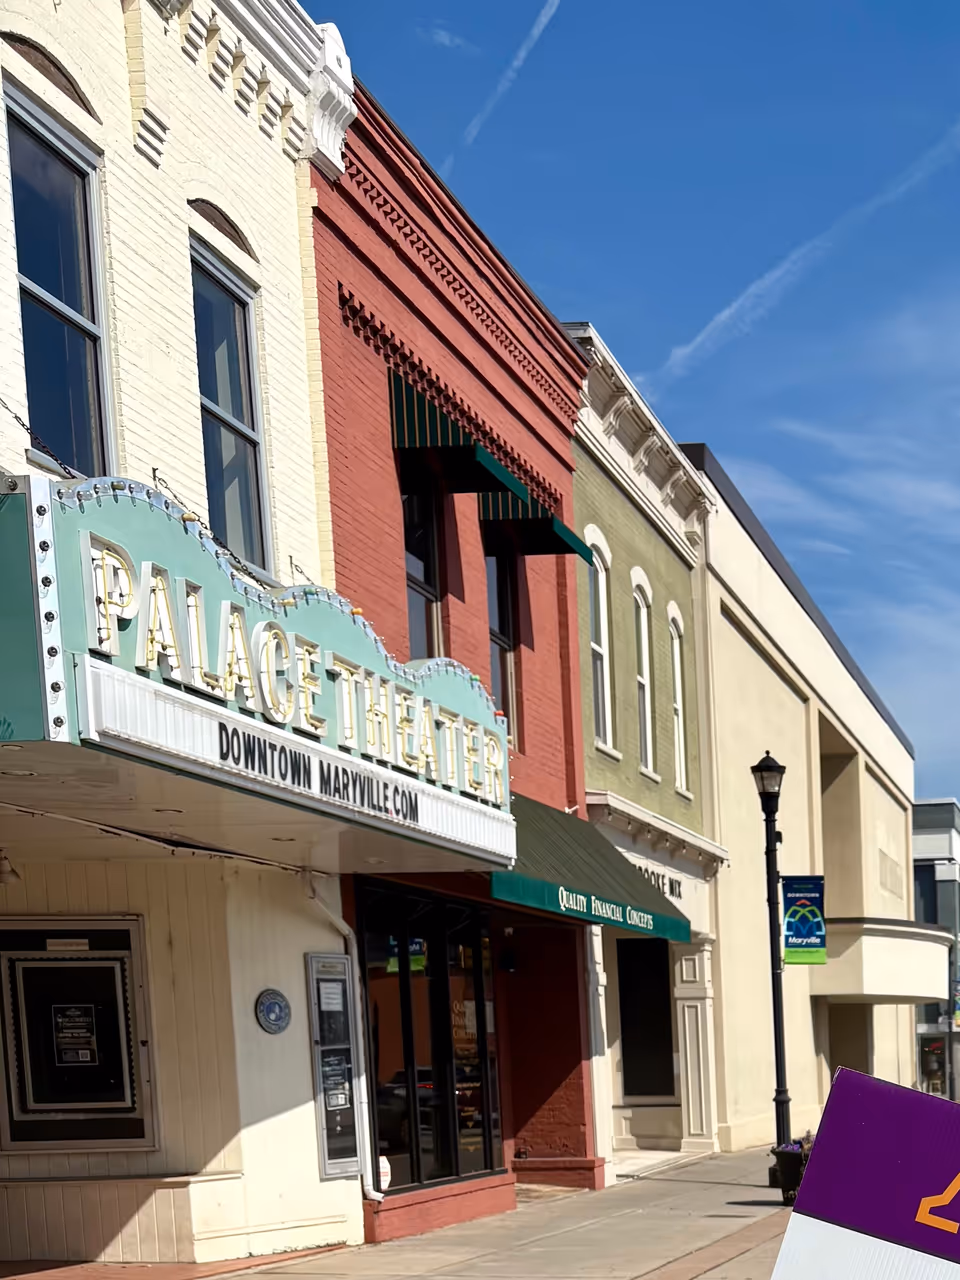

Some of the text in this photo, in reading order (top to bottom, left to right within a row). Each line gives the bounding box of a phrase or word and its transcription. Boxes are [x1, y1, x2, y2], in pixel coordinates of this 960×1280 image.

[79, 530, 508, 808] PALACE THEATER
[218, 722, 419, 823] DOWNTOWN MARYVILLE.COM
[558, 886, 653, 929] QUALITY FINANCIAL CONCEPTS
[788, 936, 821, 945] Maryville
